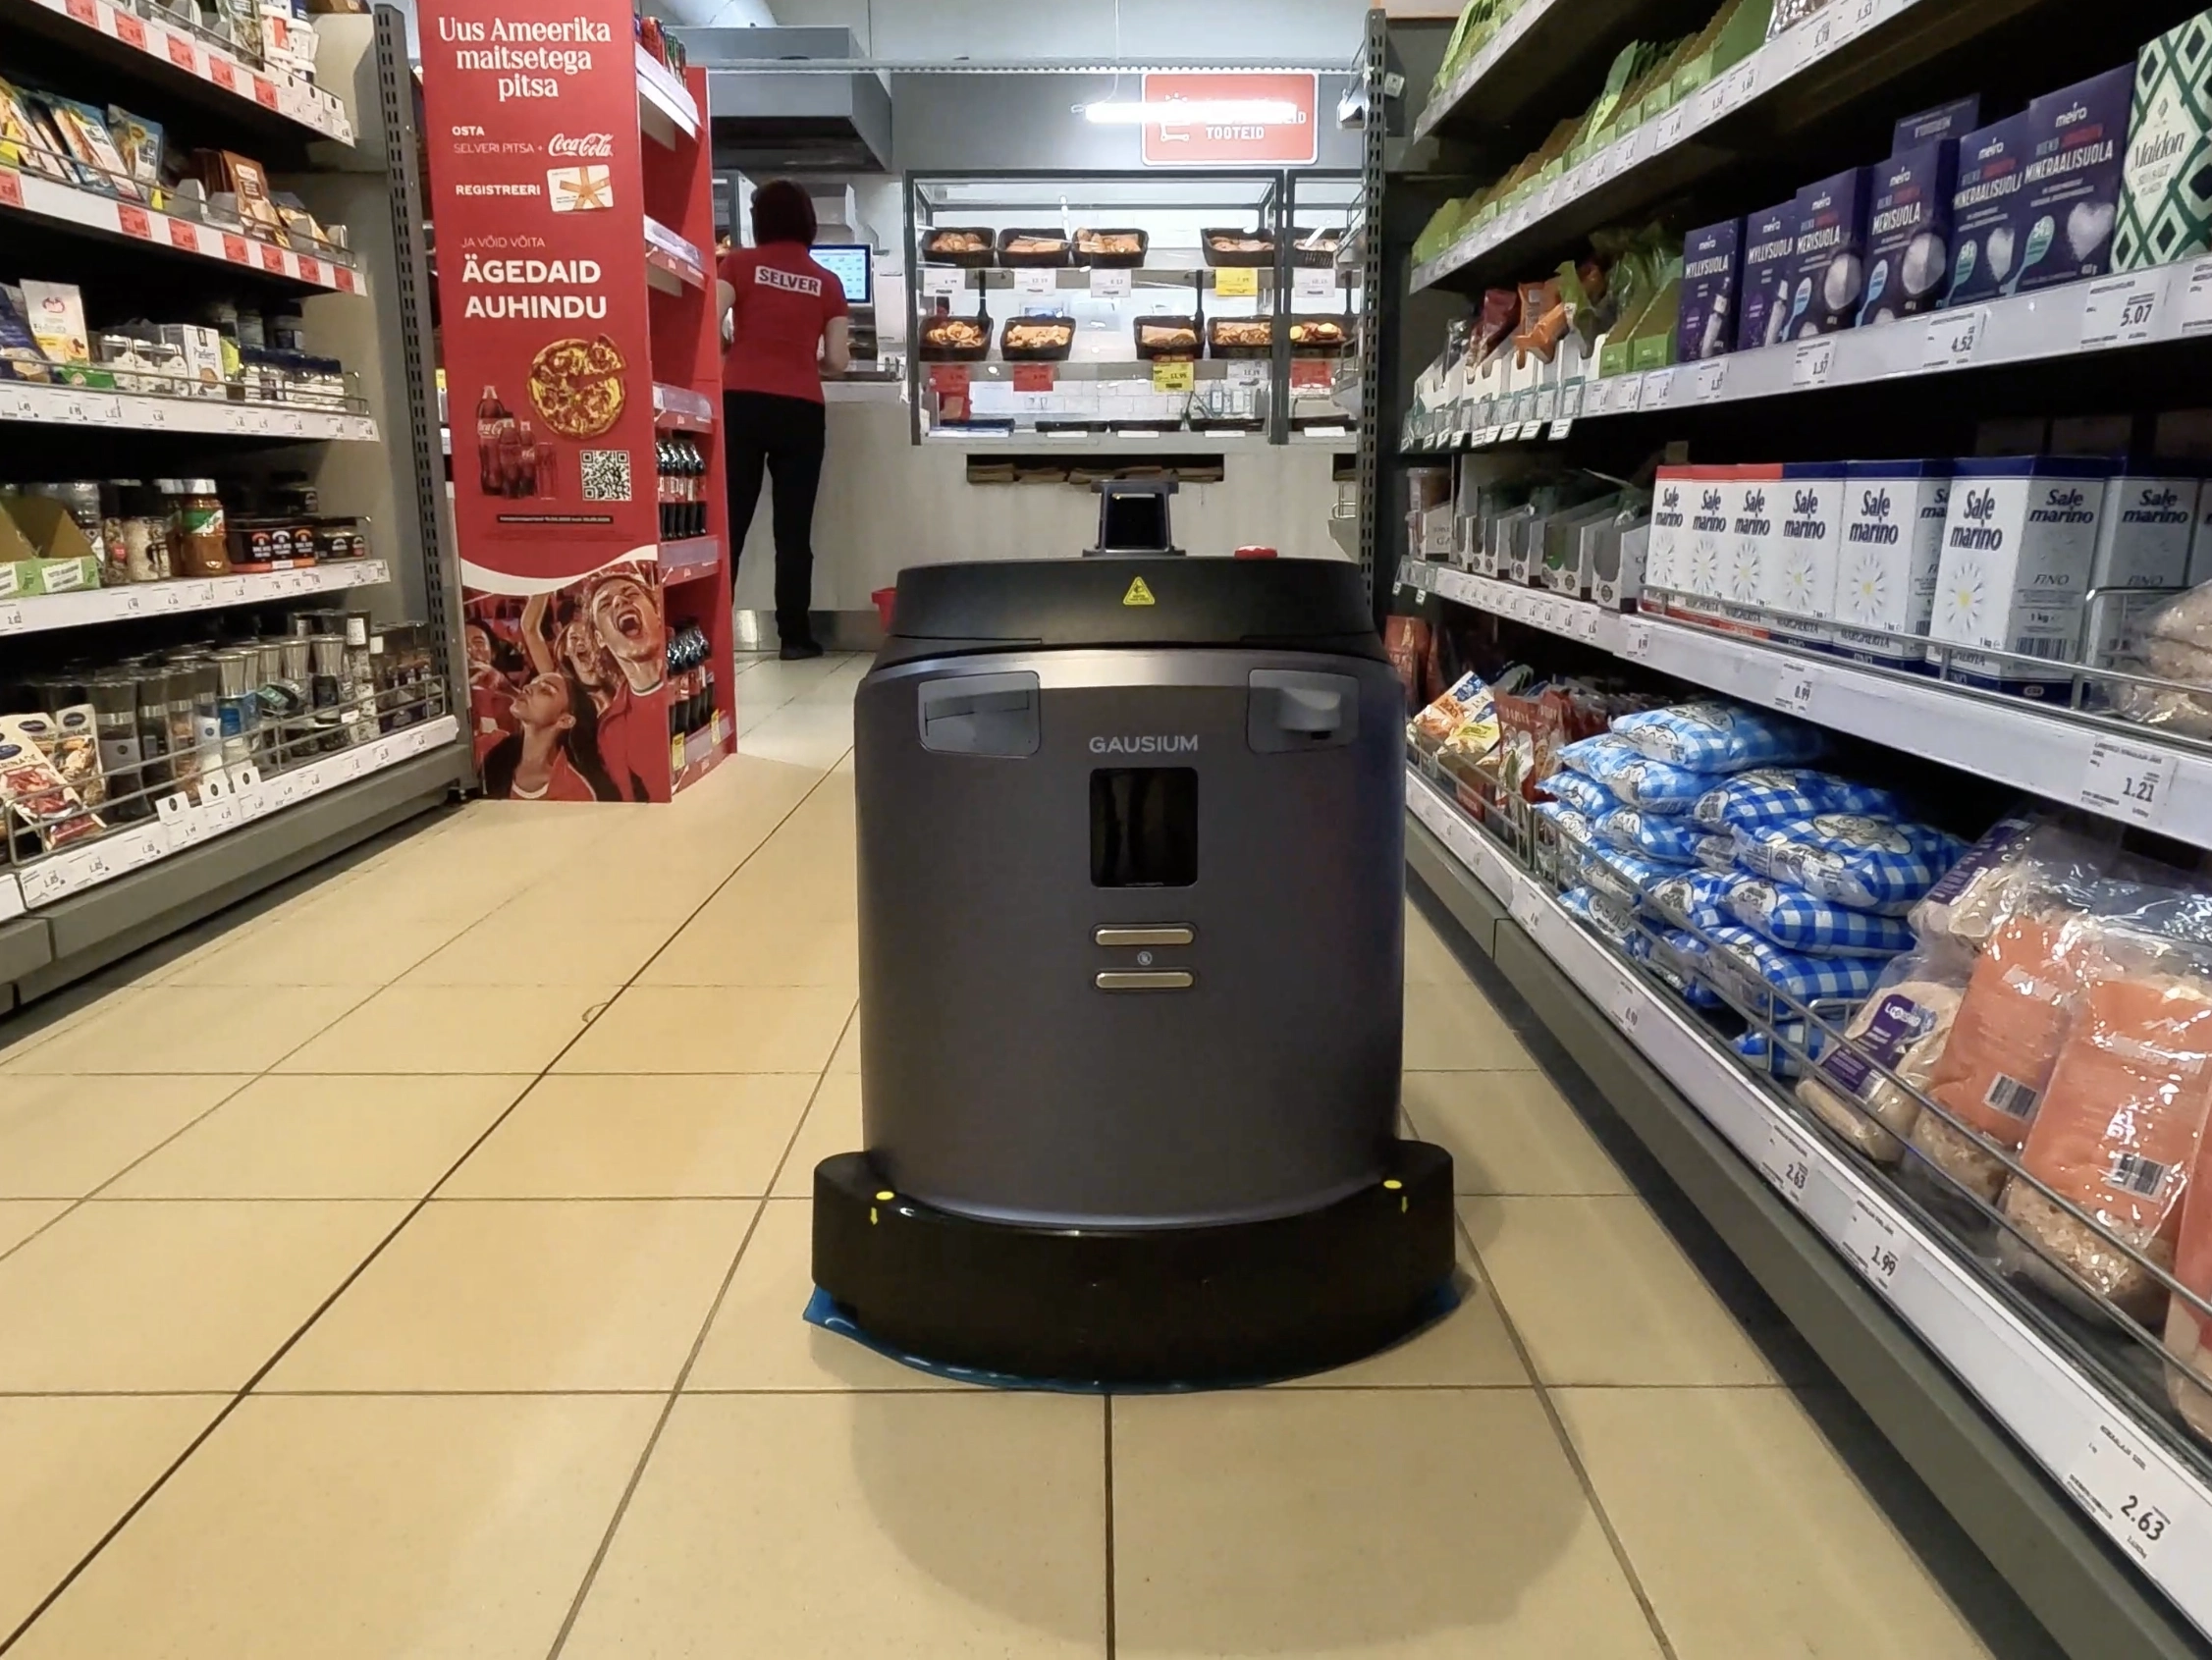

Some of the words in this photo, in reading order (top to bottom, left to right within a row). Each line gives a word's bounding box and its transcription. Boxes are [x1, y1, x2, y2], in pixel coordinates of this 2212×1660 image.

[439, 17, 485, 42] Uus
[490, 17, 612, 43] Ameerika
[456, 46, 593, 76] maitsetega
[498, 74, 559, 102] pitsa
[452, 126, 485, 136] OSTA
[1206, 127, 1265, 139] TOOTEID
[454, 142, 500, 154] SELVERI
[503, 142, 535, 154] PITSA
[2131, 130, 2185, 173] Maldon
[2024, 139, 2114, 185] MINERAALISUOLA
[456, 185, 541, 195] REGISTREERI
[1872, 201, 1921, 236] MERISUOLA
[461, 237, 476, 247] JA
[477, 235, 508, 247] VÕID
[511, 235, 546, 247] VÕITA
[1748, 237, 1794, 265] MYLLYSUOLA
[1797, 225, 1841, 255] MERISUOLA
[462, 253, 601, 284] ÄGEDAID
[1685, 254, 1729, 280] MYLLYSUOLA
[758, 268, 820, 294] SELVER
[464, 295, 607, 319] AUHINDU
[2120, 304, 2153, 327] 5.07
[1951, 336, 1973, 352] 4.52
[1662, 486, 1680, 508] Sale
[1701, 488, 1721, 510] Sale
[1744, 487, 1765, 512] Sale
[1793, 487, 1818, 514] Sale
[1861, 488, 1891, 517] Sale
[1963, 487, 1995, 519] Sale
[2046, 489, 2083, 507] Sale
[2139, 489, 2178, 507] Sale
[1654, 508, 1684, 527] marino
[1693, 510, 1727, 532] marino
[1734, 512, 1771, 536] marino
[1783, 514, 1826, 540] marino
[2029, 508, 2094, 524] marino
[2122, 508, 2188, 523] marino
[1849, 516, 1900, 545] marino
[1950, 519, 2003, 551] marino
[2033, 574, 2070, 585] FINO
[2127, 575, 2163, 586] FINO
[2037, 613, 2050, 623] kg
[1090, 735, 1199, 753] GAUSIUM
[2123, 776, 2155, 803] 1.21
[1786, 1163, 1807, 1189] 2.63
[1871, 1245, 1896, 1276] 1.99
[2121, 1495, 2165, 1541] 2.63
